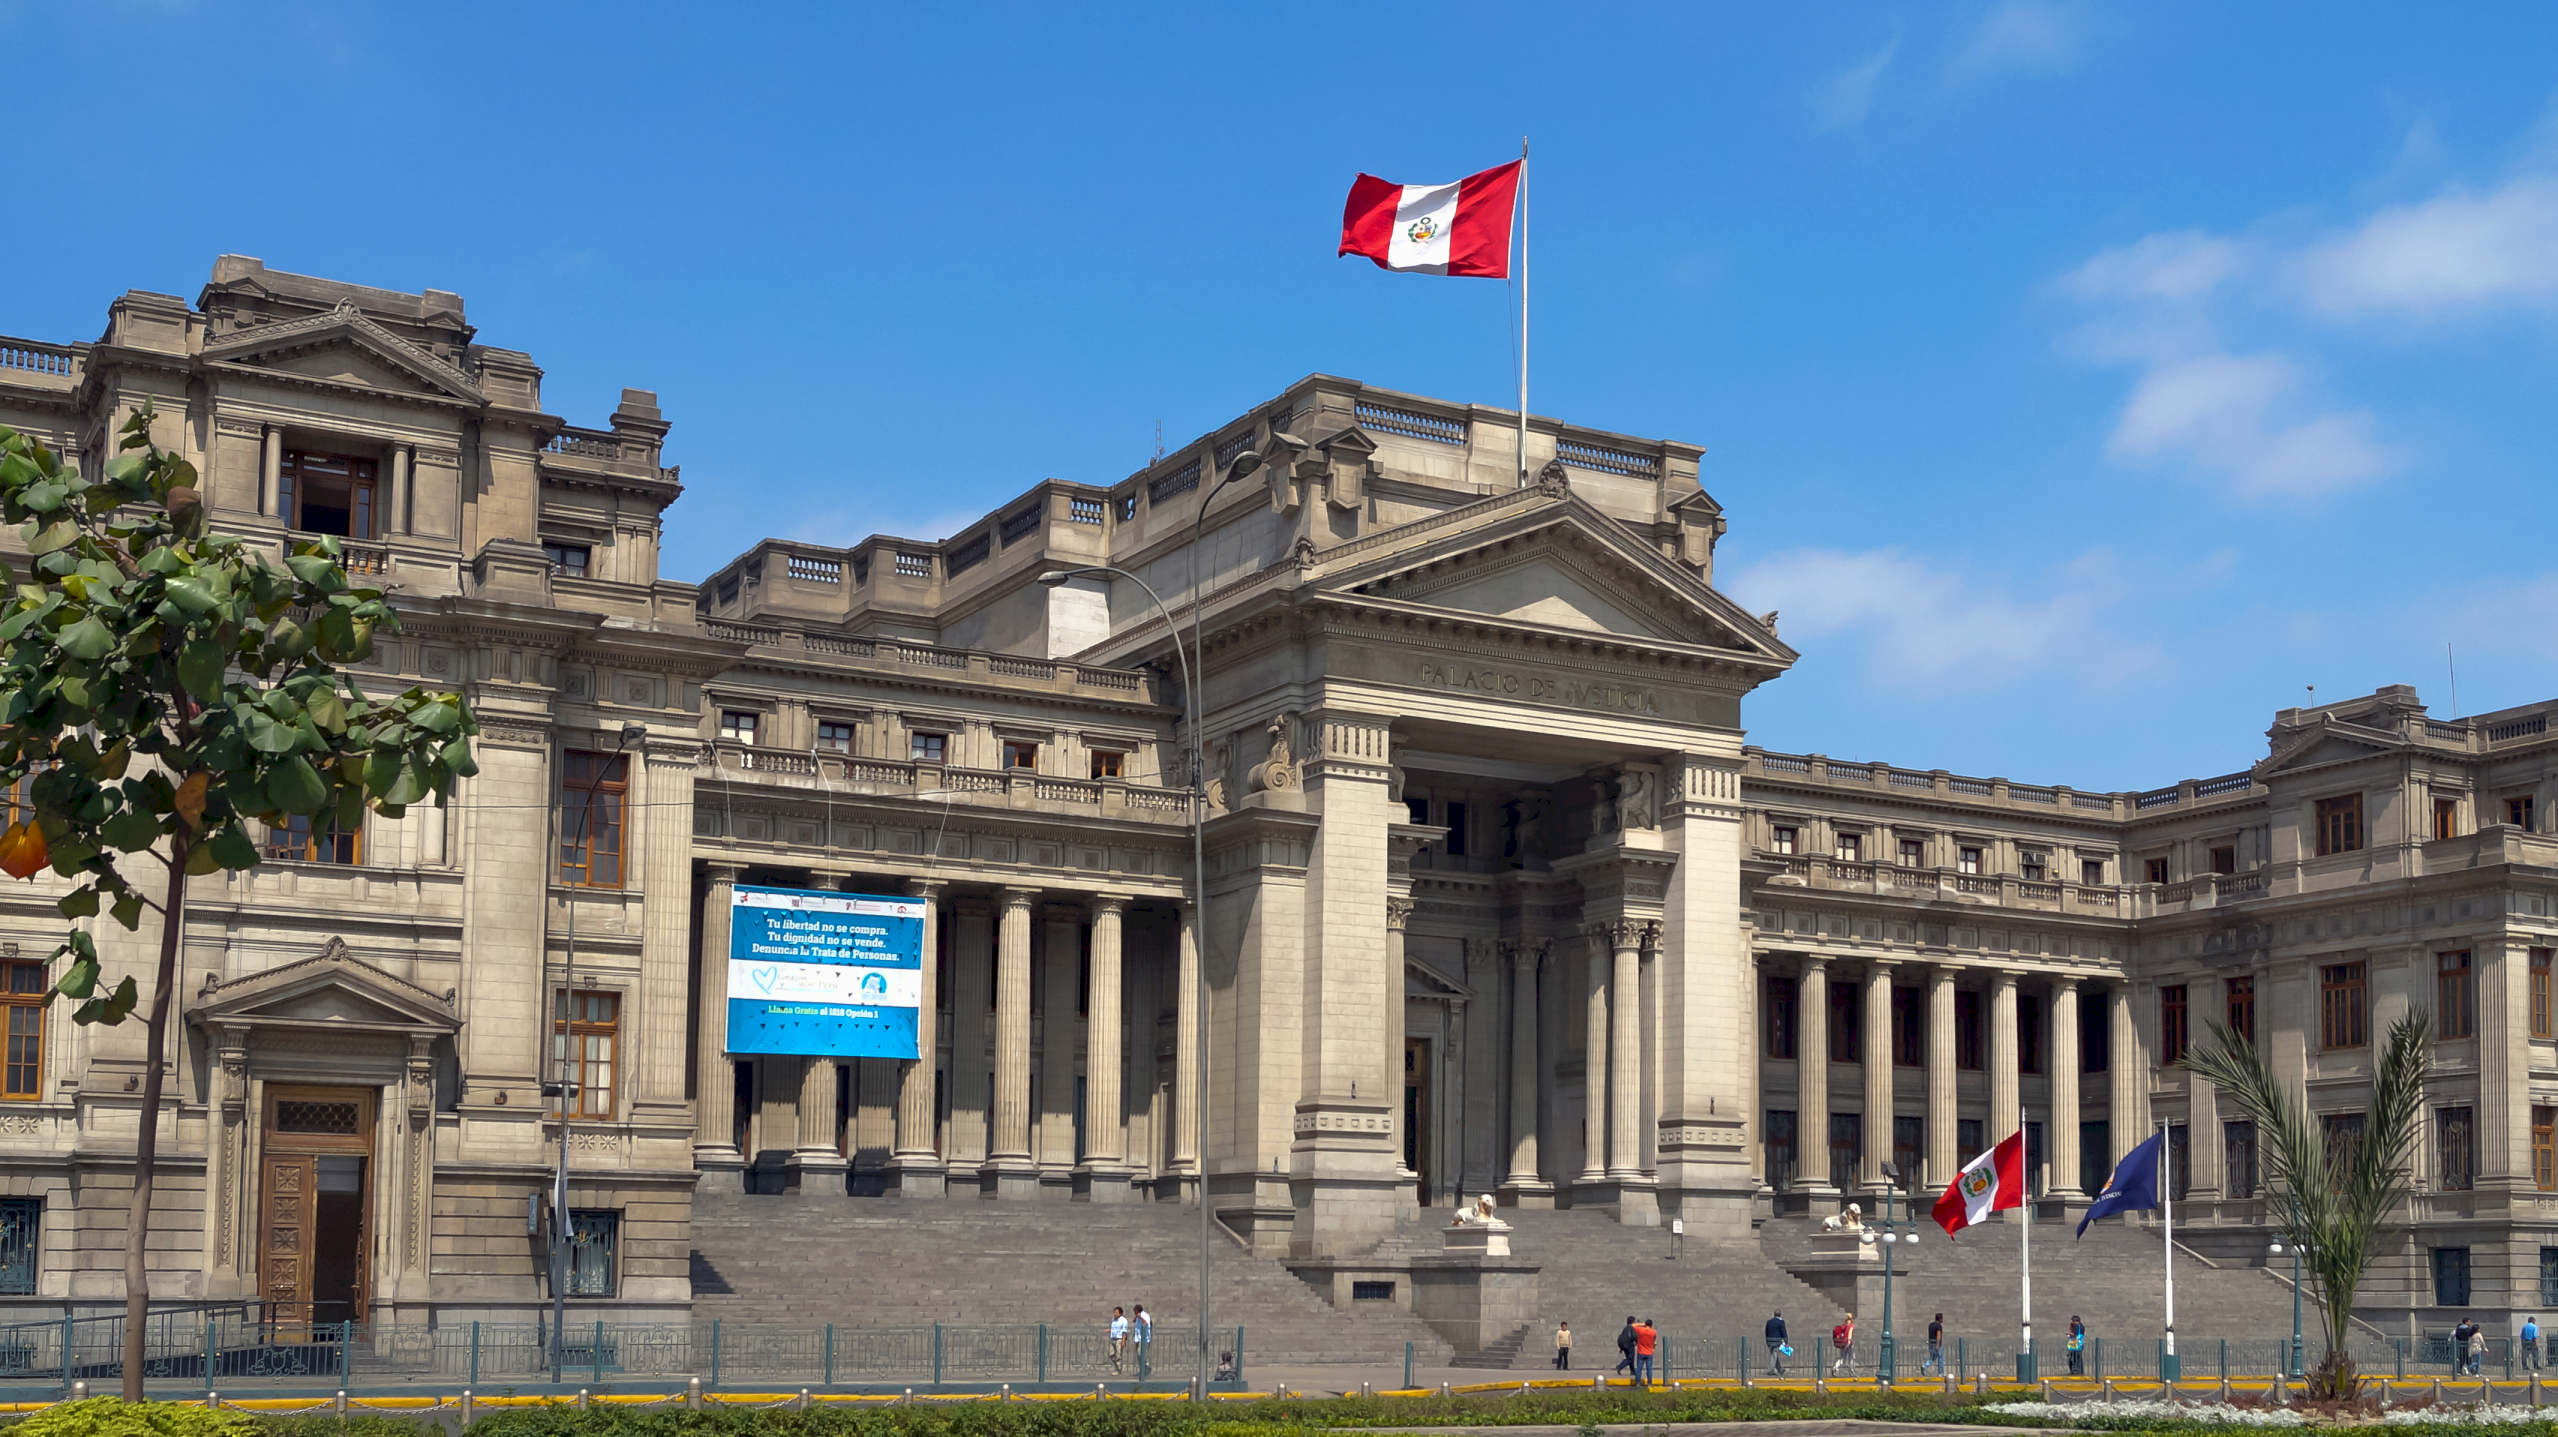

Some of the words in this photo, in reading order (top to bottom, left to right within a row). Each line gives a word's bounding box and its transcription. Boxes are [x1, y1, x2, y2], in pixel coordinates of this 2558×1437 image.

[1422, 663, 1518, 693] PALACIO
[1531, 678, 1556, 699] DE
[767, 918, 780, 928] Tu
[782, 919, 820, 931] libertad
[821, 924, 834, 932] no
[836, 925, 848, 933] se
[849, 926, 888, 936] compra.
[767, 931, 781, 941] Tu
[783, 932, 825, 944] dignidad
[826, 937, 840, 945] no
[841, 938, 853, 946] se
[854, 937, 886, 948] vende.
[752, 943, 798, 955] Denuncia
[811, 946, 837, 957] Trata
[838, 948, 851, 958] de
[852, 949, 900, 961] Personas.
[794, 1006, 819, 1015] Gratis
[820, 1007, 828, 1016] al
[829, 1008, 845, 1017] 1818
[845, 1009, 874, 1018] Opción
